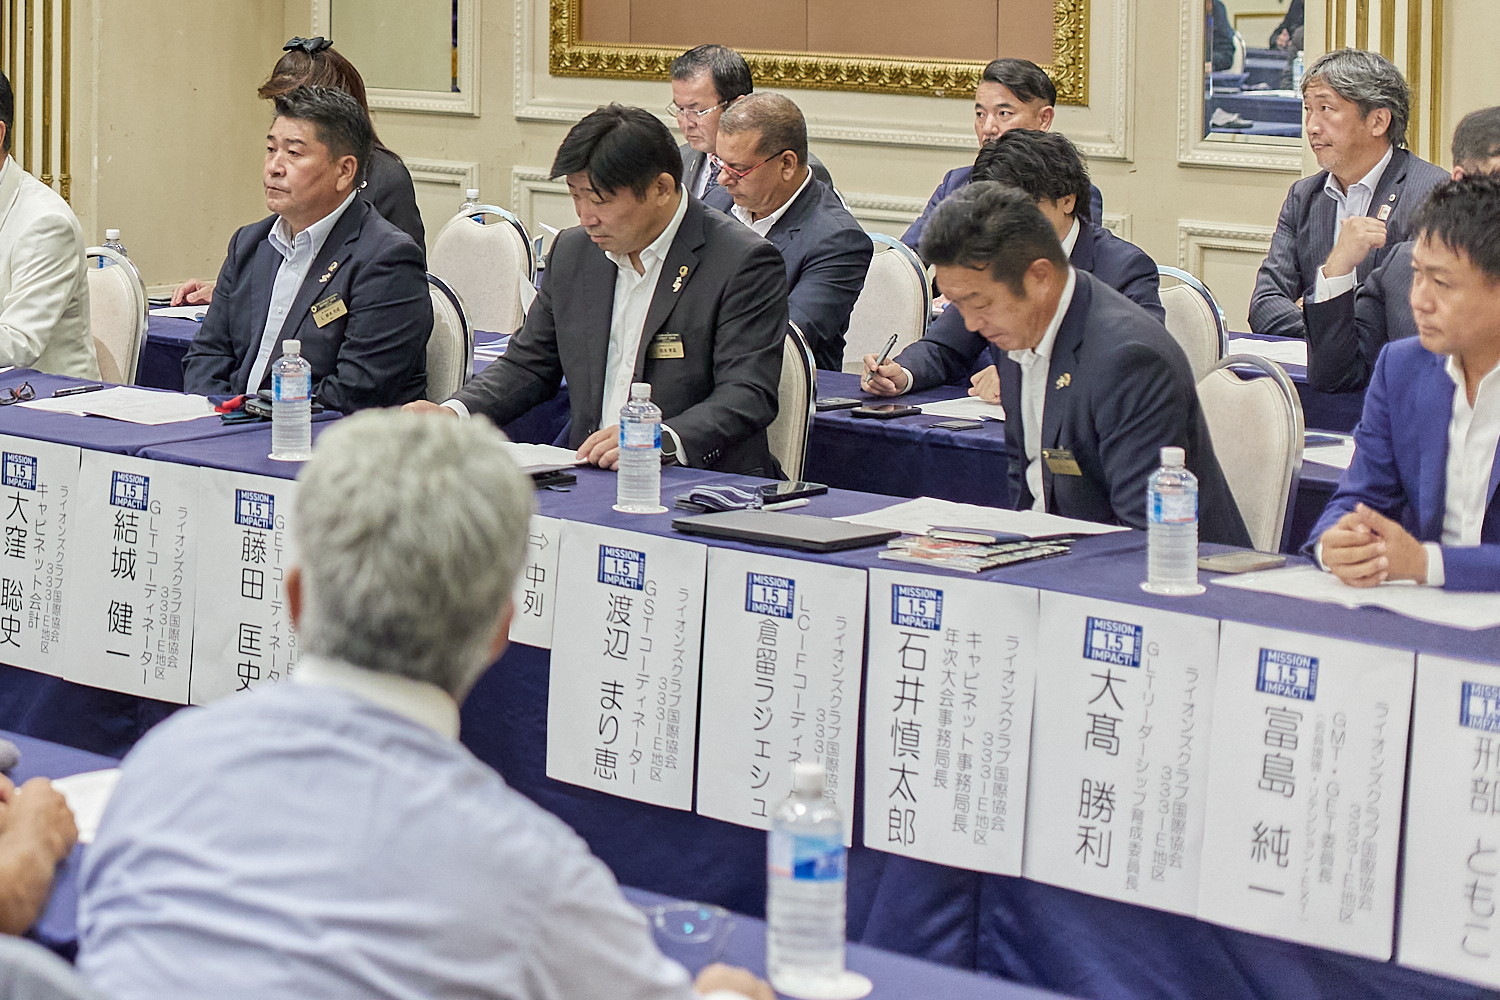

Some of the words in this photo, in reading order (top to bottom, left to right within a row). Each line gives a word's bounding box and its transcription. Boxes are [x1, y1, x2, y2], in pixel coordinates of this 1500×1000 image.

[6, 453, 33, 466] MISSION
[12, 464, 26, 478] 1.5
[117, 472, 145, 484] MISSION
[6, 477, 32, 489] IMPACT!
[122, 483, 137, 498] 1.5
[115, 496, 143, 509] IMPACT!
[241, 490, 270, 503] MISSION
[248, 502, 262, 517] 1.5
[4, 491, 29, 560] 大窪
[239, 516, 269, 529] IMPACT!
[110, 509, 139, 581] 結城
[604, 546, 639, 562] MISSION
[28, 482, 49, 629] キャビネット会計
[241, 529, 267, 600] 藤田
[613, 559, 631, 577] 1.5
[603, 574, 638, 589] IMPACT!
[752, 573, 789, 589] MISSION
[523, 563, 546, 618] 中列
[761, 587, 780, 604] 1.5
[898, 585, 936, 601] MISSION
[0, 577, 24, 648] 聡史
[751, 602, 787, 618] IMPACT!
[908, 599, 927, 617] 1.5
[106, 599, 133, 657] 健一
[603, 592, 634, 661] 渡辺
[897, 615, 935, 630] IMPACT!
[1093, 619, 1135, 636] MISSION
[1104, 633, 1124, 651] 1.5
[235, 623, 262, 693] 匡史
[1091, 650, 1133, 667] IMPACT!
[1267, 651, 1311, 668] MISSION
[1276, 664, 1299, 685] 1.5
[1264, 683, 1308, 700] IMPACT!
[933, 628, 960, 790] 年次大会事務局長
[593, 679, 625, 781] まり恵
[888, 631, 930, 847] 石井慎太郎
[951, 631, 983, 834] キャビネット事務局長
[1258, 706, 1303, 799] 富島
[1075, 778, 1116, 869] 勝利
[1248, 820, 1292, 896] 純一
[1461, 837, 1497, 960] ともこ
